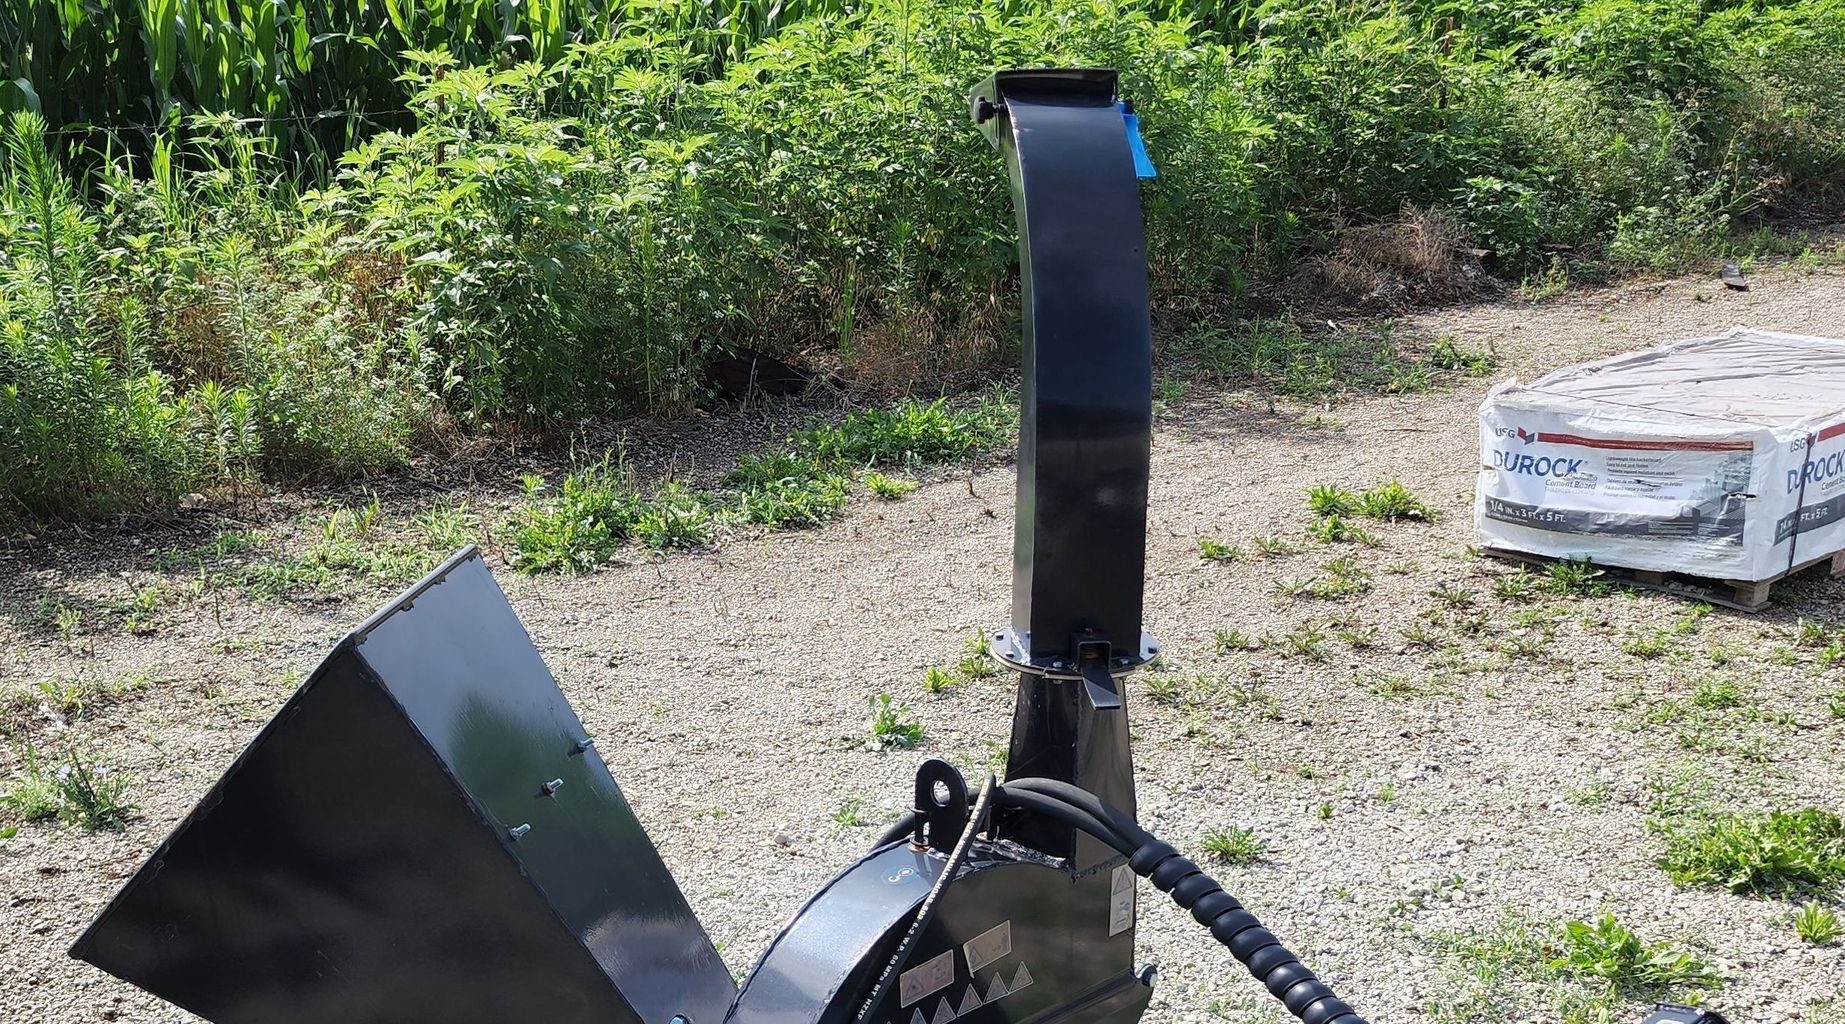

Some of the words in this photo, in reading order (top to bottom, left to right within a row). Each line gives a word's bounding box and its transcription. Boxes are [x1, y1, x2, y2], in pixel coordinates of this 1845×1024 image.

[1495, 427, 1515, 439] USG
[1493, 449, 1583, 478] DUROCK
[1545, 478, 1574, 488] Cement
[1574, 481, 1596, 490] Board
[1490, 500, 1504, 512] 1/4
[1521, 508, 1527, 517] 3
[1547, 512, 1553, 521] 5
